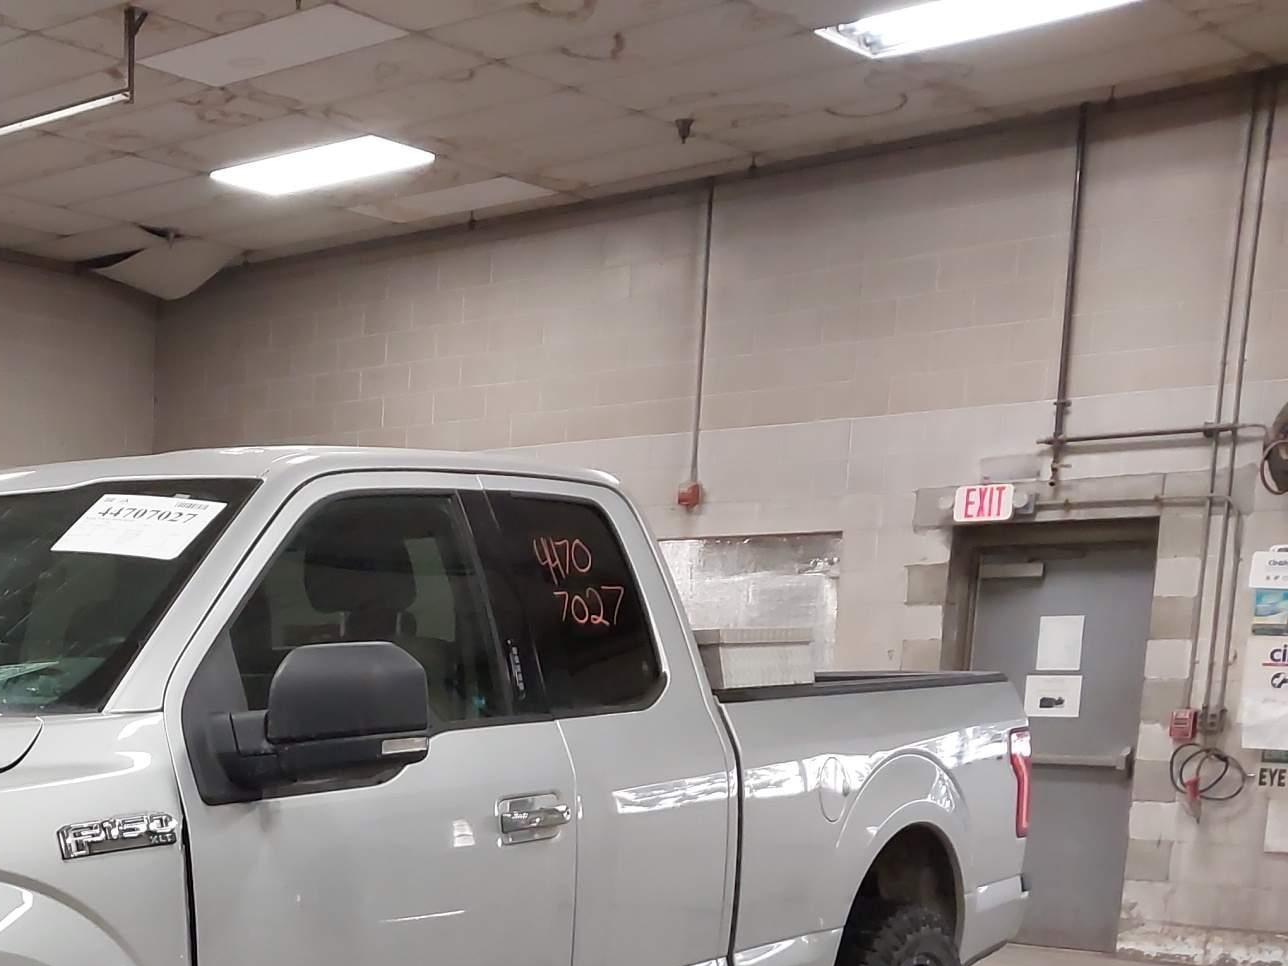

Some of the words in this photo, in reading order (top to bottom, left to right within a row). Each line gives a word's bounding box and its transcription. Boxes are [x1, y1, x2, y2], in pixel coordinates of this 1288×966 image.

[98, 506, 199, 524] 44707027
[964, 487, 1006, 518] EXIT
[533, 537, 592, 588] 4470
[553, 585, 625, 627] 7027
[1258, 767, 1287, 788] EYE
